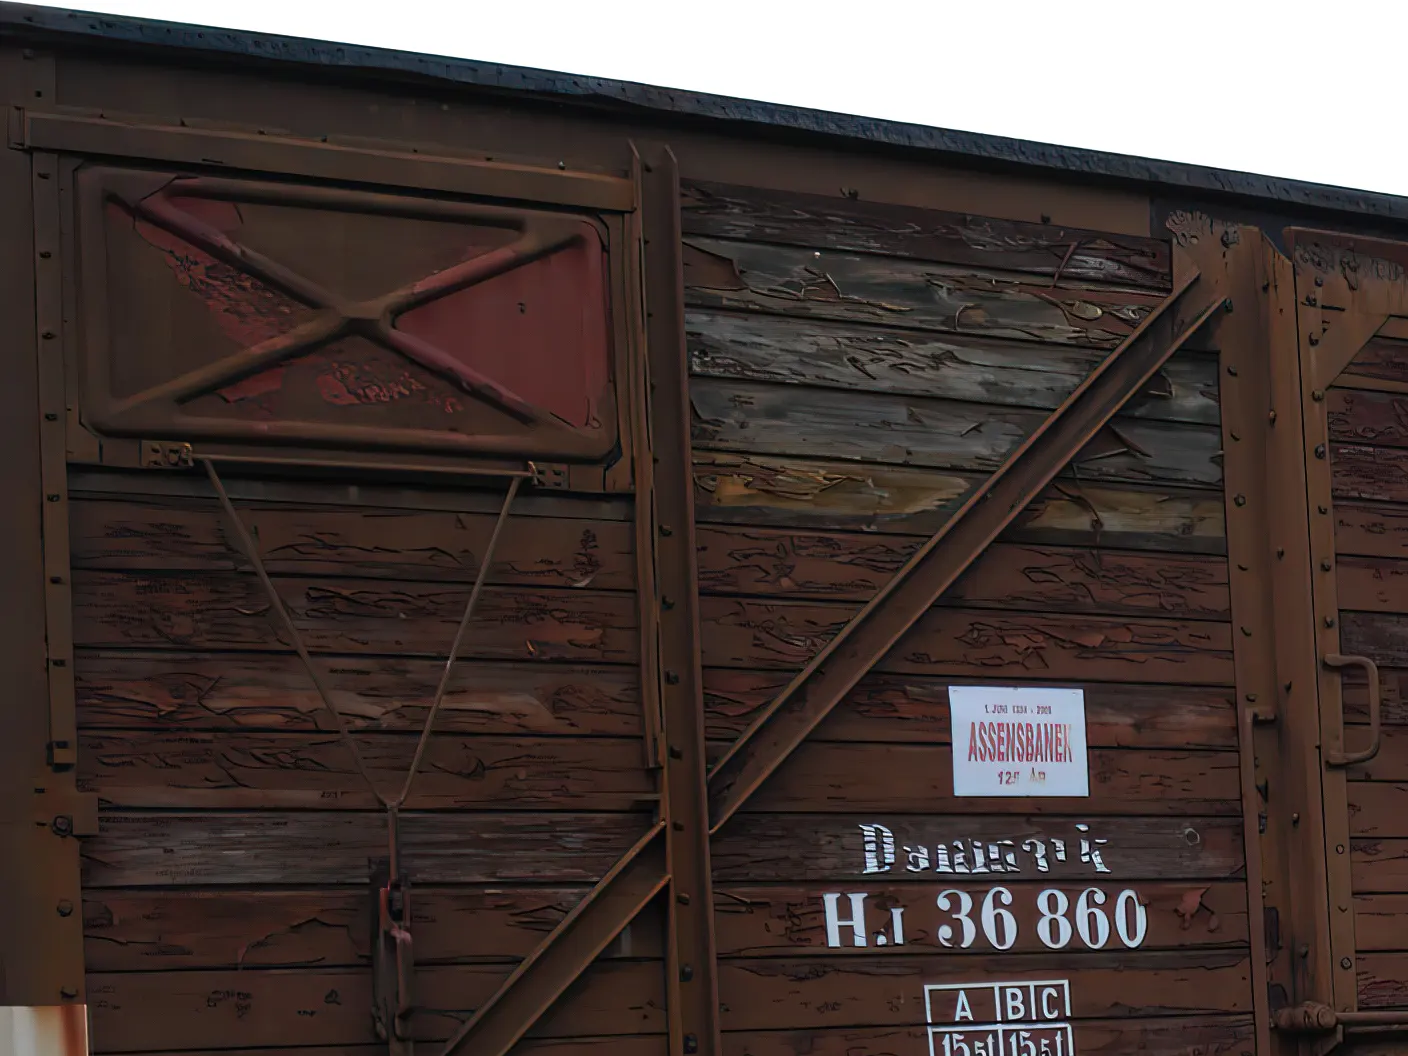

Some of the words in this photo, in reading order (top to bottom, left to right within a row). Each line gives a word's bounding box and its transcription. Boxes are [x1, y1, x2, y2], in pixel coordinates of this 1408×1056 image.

[954, 990, 974, 1022] A
[1005, 987, 1026, 1021] B
[1041, 986, 1059, 1020] C
